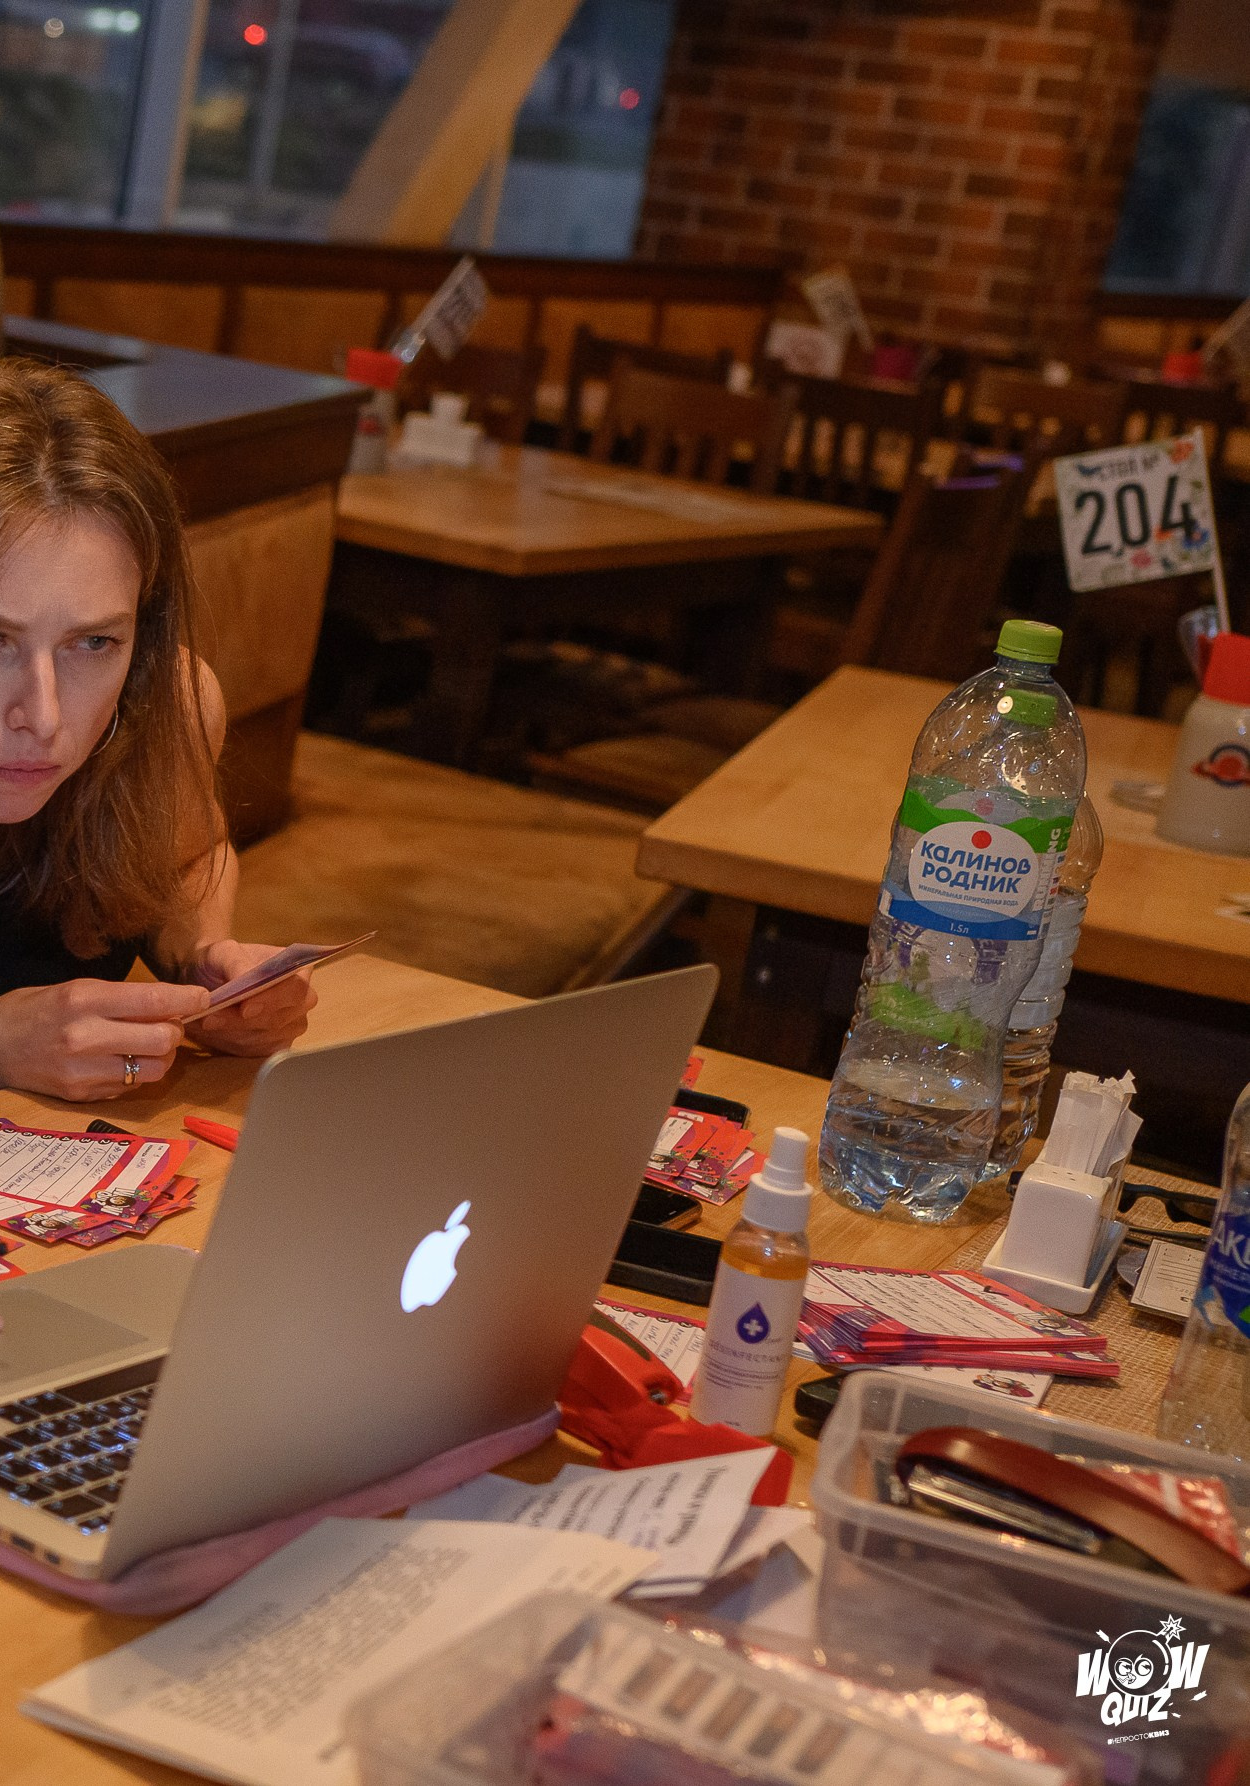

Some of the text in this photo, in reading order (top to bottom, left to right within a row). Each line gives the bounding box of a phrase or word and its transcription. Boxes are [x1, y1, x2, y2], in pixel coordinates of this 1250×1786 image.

[1074, 474, 1197, 557] 204
[921, 840, 1031, 875] КАЛИНОВ
[921, 862, 1021, 894] РОДНИК
[963, 895, 1003, 906] ПРИРОДНАЯ
